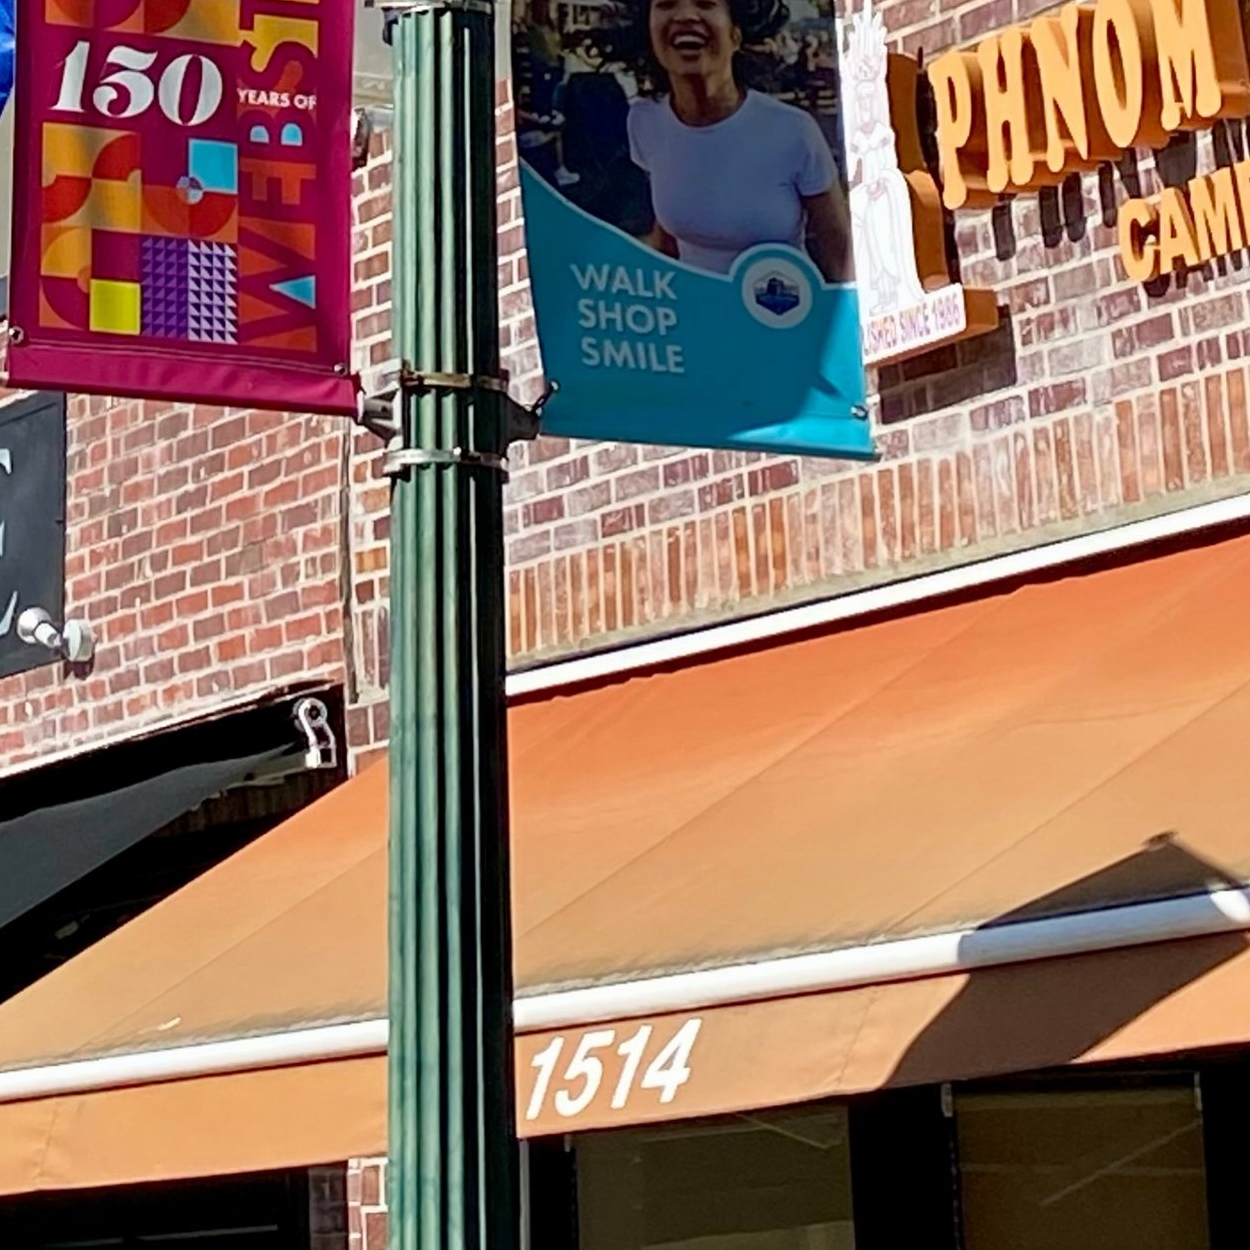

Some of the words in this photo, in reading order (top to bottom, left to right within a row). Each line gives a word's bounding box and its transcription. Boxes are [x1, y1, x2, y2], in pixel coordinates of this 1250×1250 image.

[49, 40, 224, 127] 150
[236, 87, 291, 108] YEARS
[293, 93, 317, 110] OF
[570, 263, 678, 300] WALK
[578, 298, 678, 336] SHOP
[581, 336, 685, 374] SMILE
[525, 1017, 703, 1120] 1514
